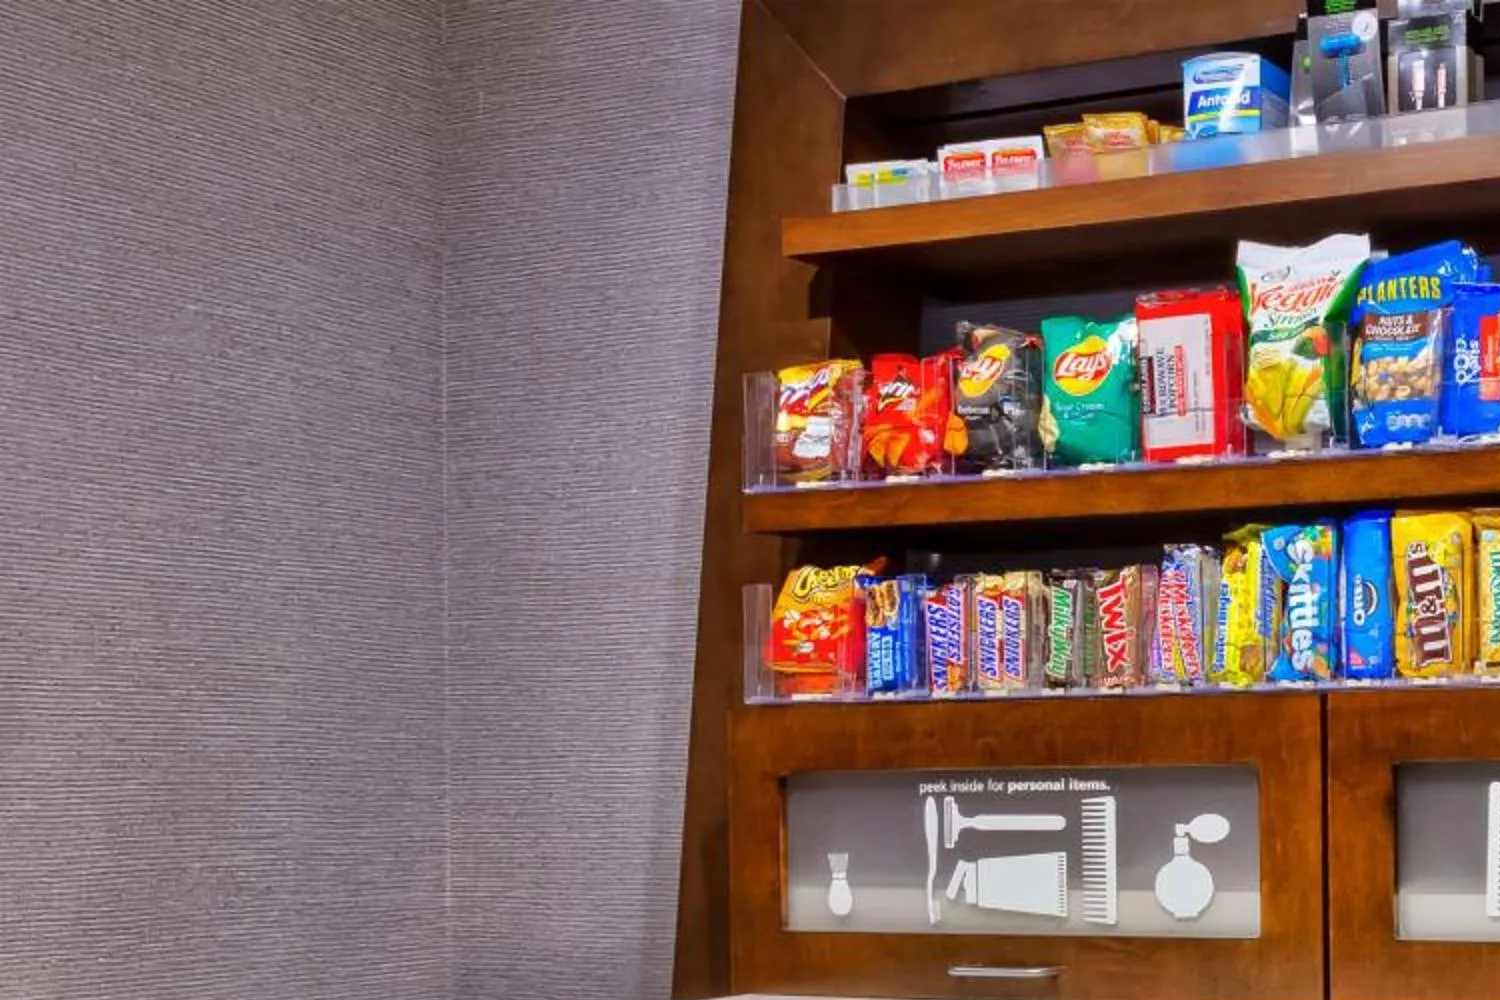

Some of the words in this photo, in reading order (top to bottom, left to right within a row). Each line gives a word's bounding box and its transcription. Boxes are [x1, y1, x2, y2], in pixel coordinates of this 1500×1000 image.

[1357, 275, 1441, 307] PLANTERS
[1286, 539, 1320, 671] Skittles
[979, 600, 997, 677] SNICKERS
[919, 778, 947, 795] peek
[951, 777, 985, 793] inside
[988, 777, 1005, 791] for
[1008, 777, 1065, 795] personal
[1069, 777, 1111, 791] items.
